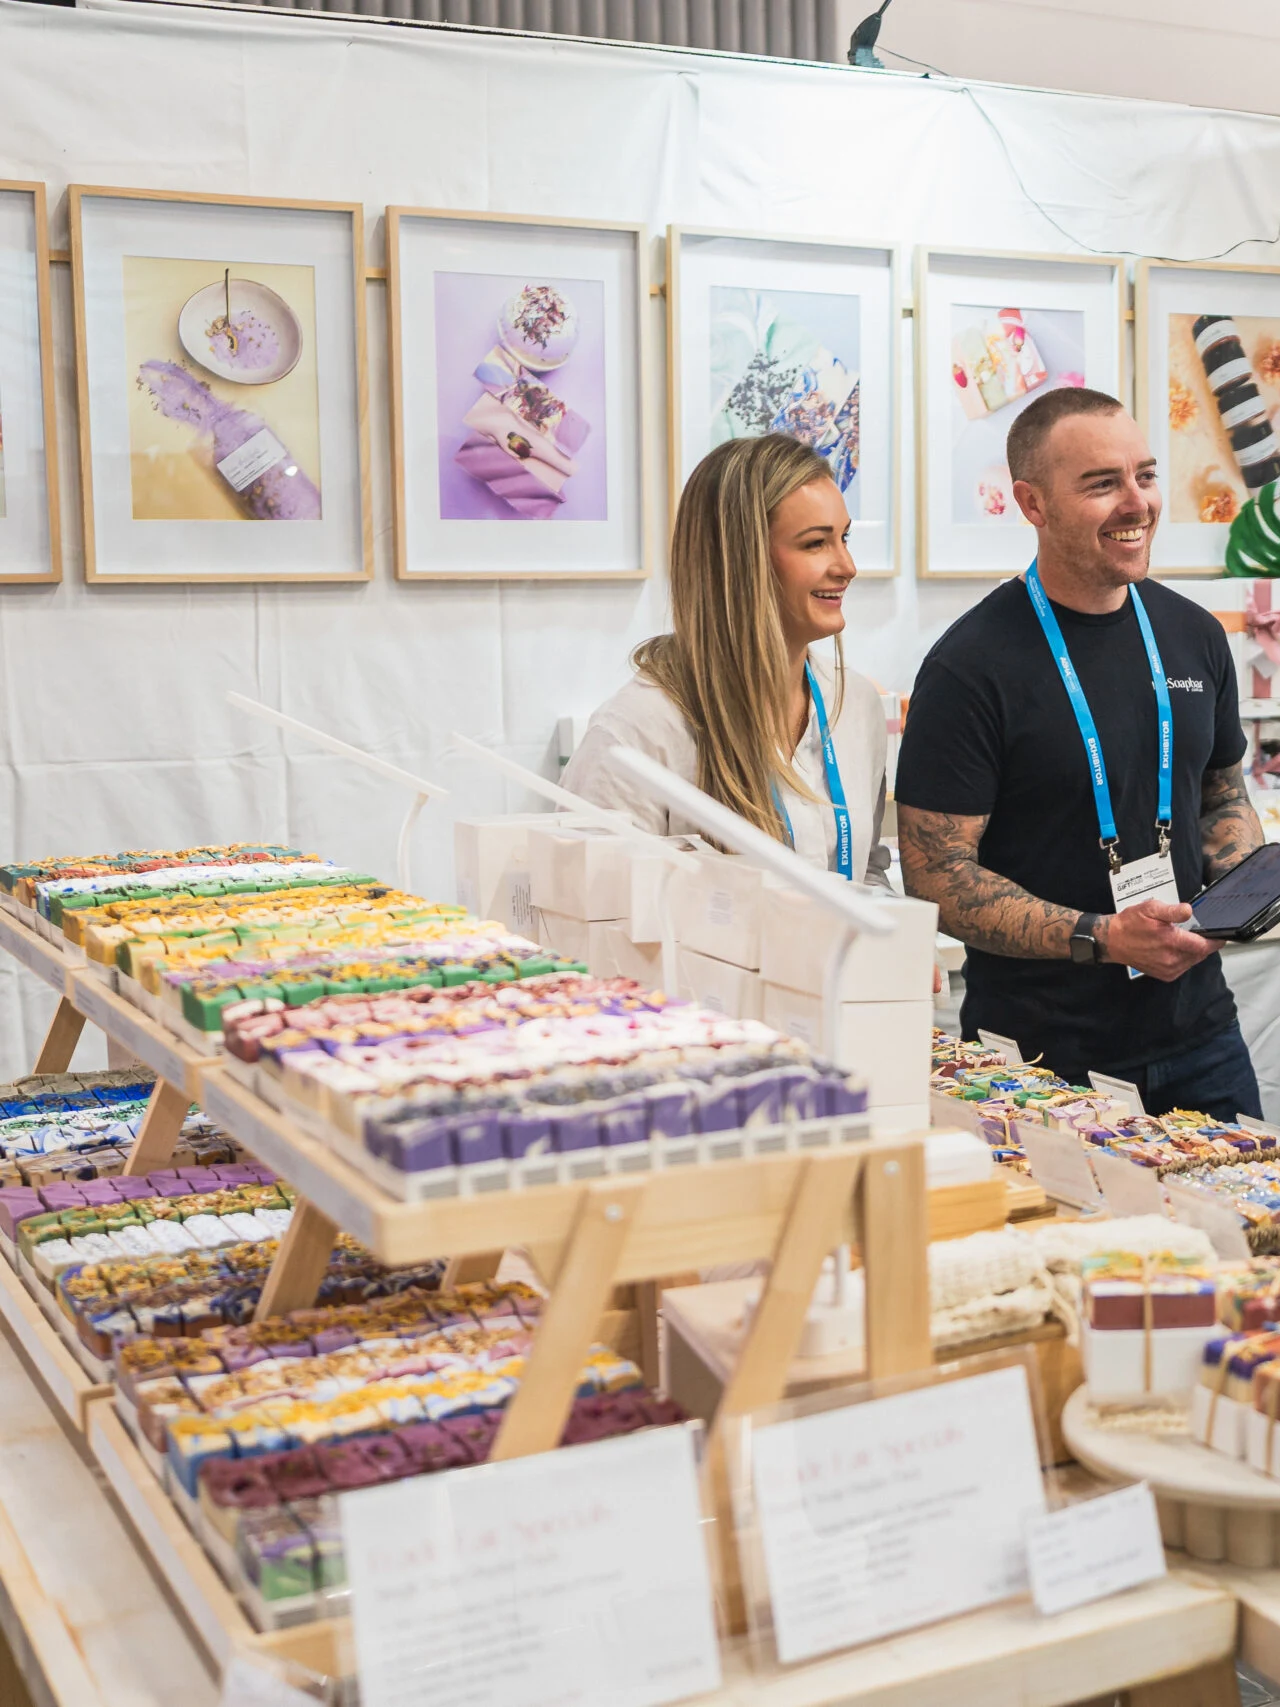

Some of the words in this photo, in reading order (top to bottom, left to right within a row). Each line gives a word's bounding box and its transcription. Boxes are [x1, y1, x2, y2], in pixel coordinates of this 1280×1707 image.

[1087, 737, 1104, 786] EXHIBITOR
[1162, 720, 1170, 769] EXHIBITOR
[840, 814, 848, 865] EXHIBITOR
